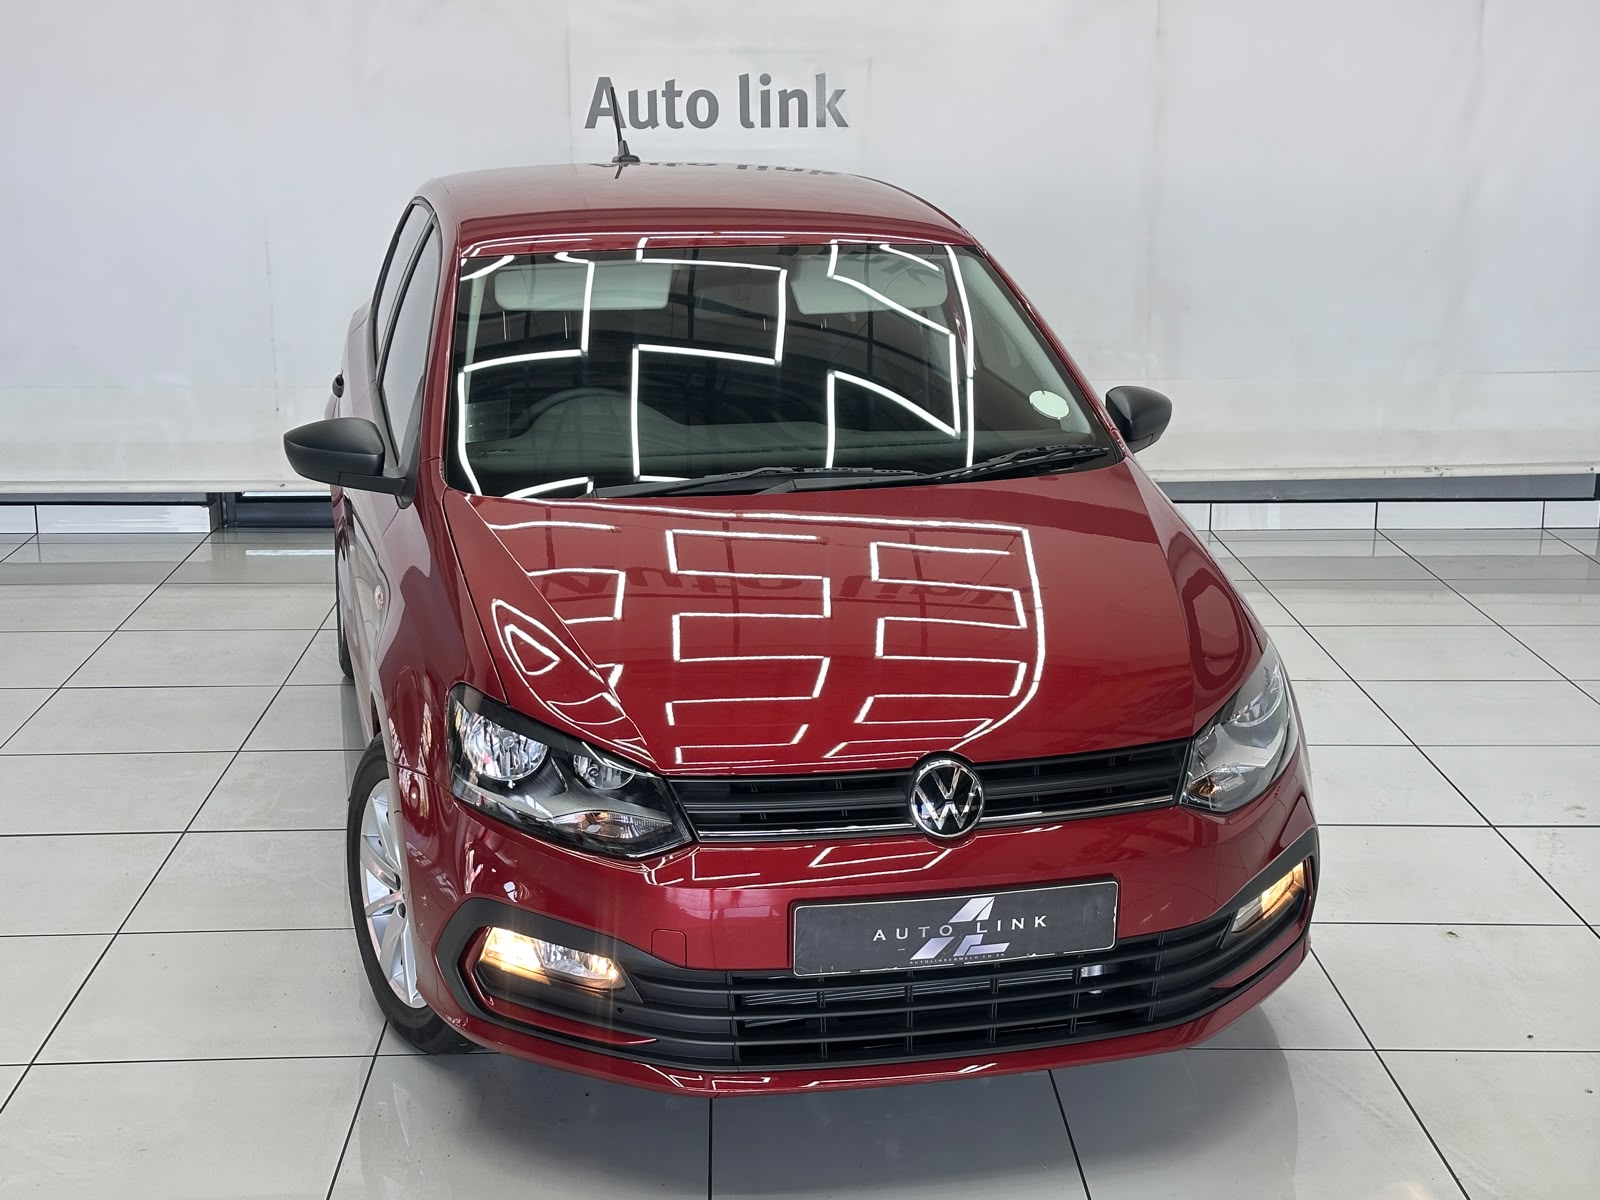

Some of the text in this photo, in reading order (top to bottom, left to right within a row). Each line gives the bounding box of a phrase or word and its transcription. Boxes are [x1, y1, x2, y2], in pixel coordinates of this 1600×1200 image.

[585, 73, 849, 129] Auto link
[873, 915, 1047, 941] AUTO LINK
